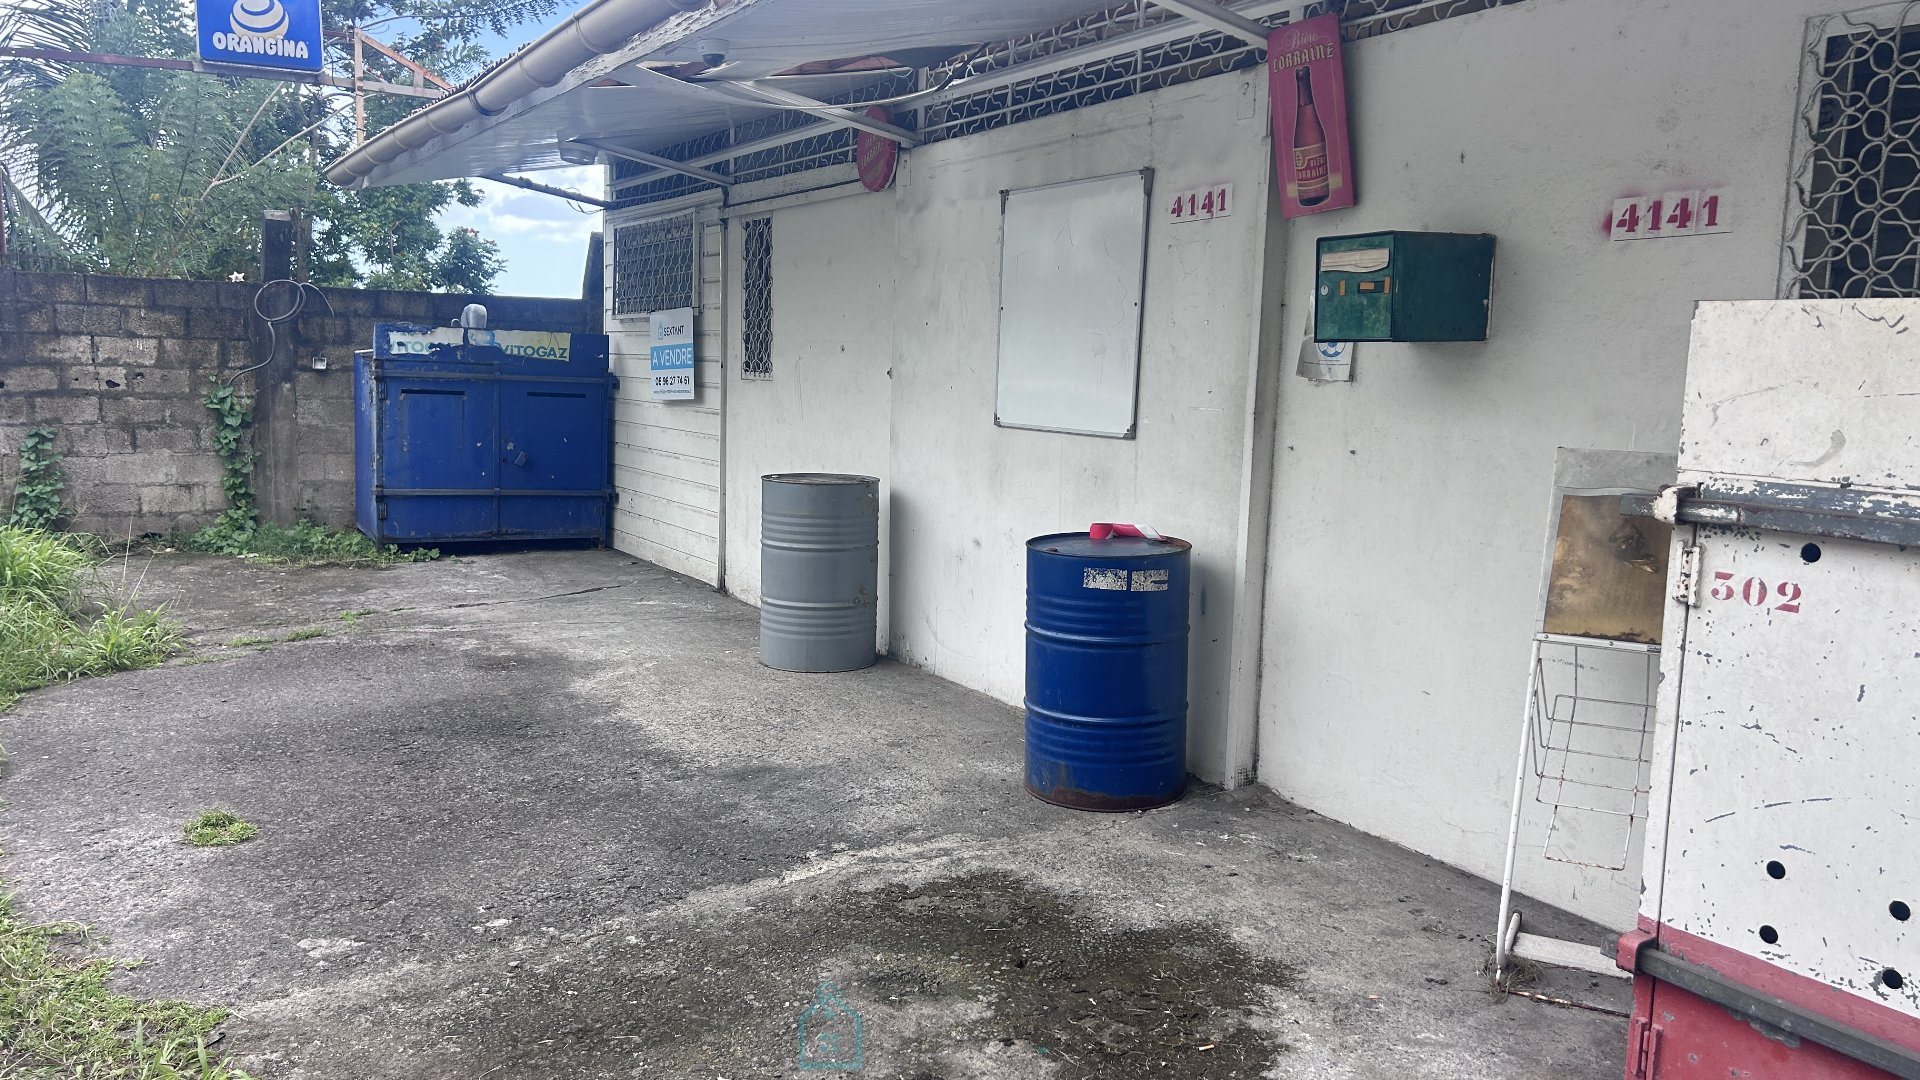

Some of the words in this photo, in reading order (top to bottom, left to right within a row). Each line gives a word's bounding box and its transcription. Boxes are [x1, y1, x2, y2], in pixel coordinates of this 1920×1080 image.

[1170, 188, 1226, 217] 4141
[1615, 195, 1719, 233] 4141
[663, 325, 685, 337] SEXTANT
[660, 348, 692, 366] VENDRE
